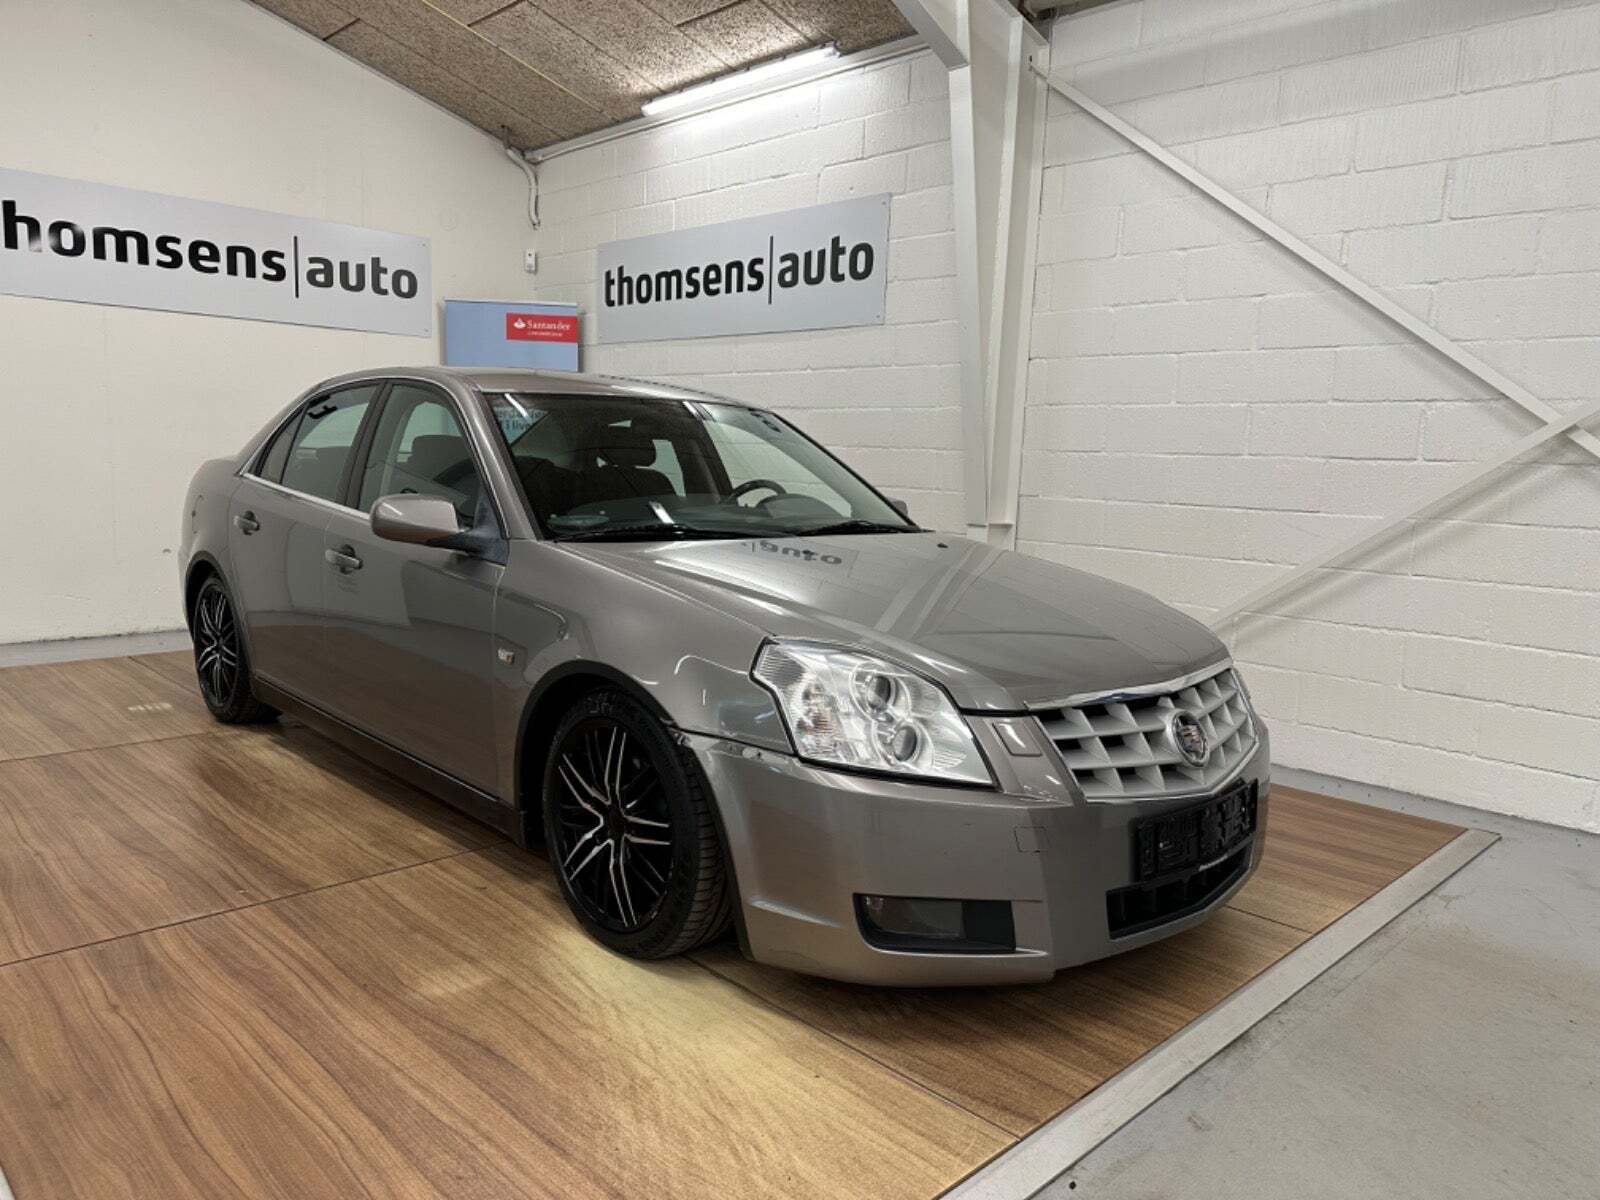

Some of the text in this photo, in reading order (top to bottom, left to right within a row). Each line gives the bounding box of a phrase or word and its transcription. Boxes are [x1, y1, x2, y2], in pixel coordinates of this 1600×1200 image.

[306, 256, 418, 299] auto
[604, 235, 874, 308] thomsens auto
[527, 319, 571, 331] Santander
